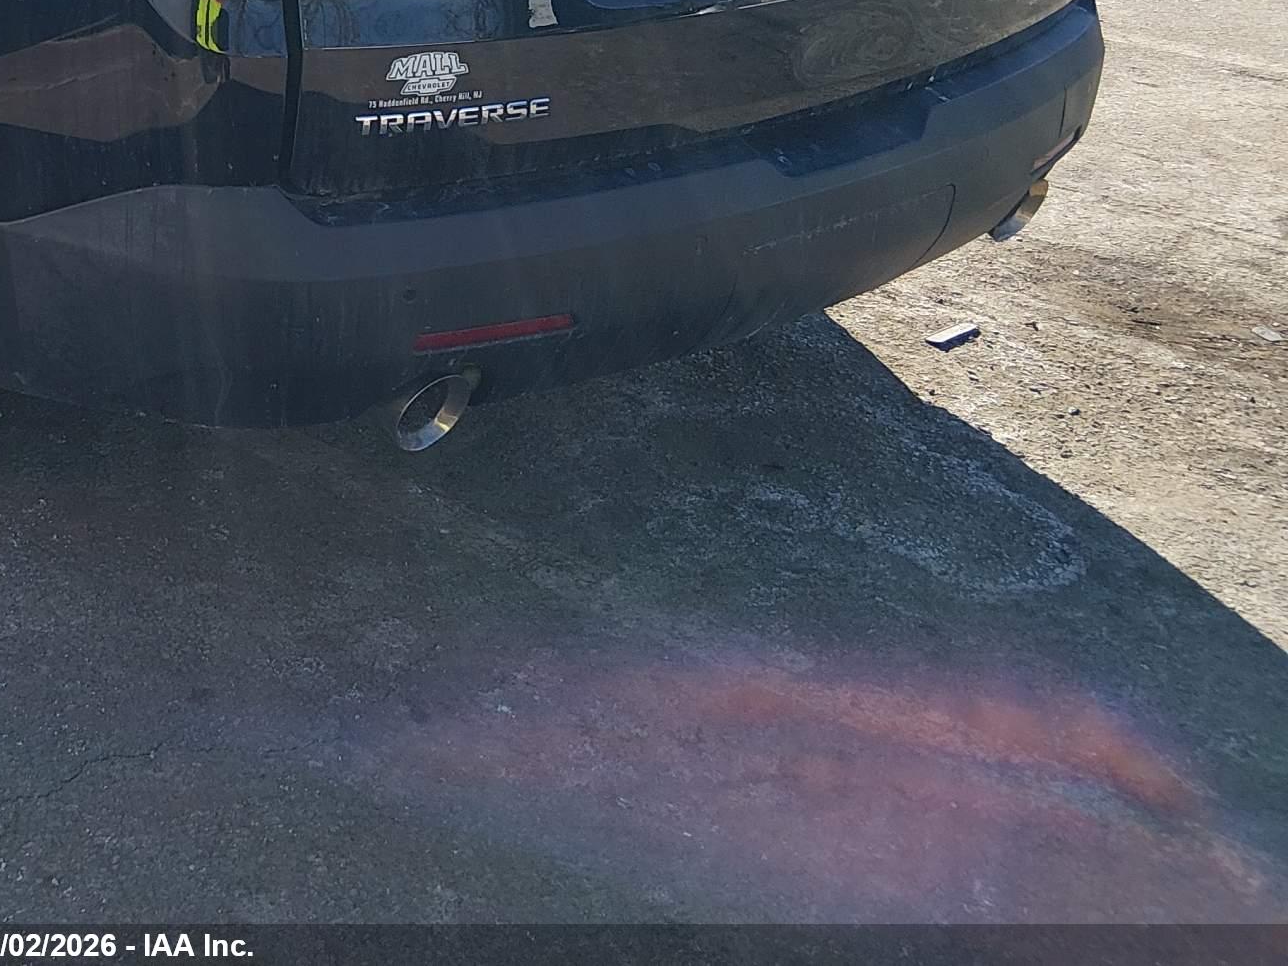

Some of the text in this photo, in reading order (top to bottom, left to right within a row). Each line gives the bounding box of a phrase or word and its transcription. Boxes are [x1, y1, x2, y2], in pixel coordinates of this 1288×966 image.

[387, 52, 469, 80] MALL
[406, 81, 451, 91] CHEVROLET
[434, 93, 457, 104] Cherry
[473, 90, 483, 99] NJ
[355, 97, 551, 136] TRAVERSE
